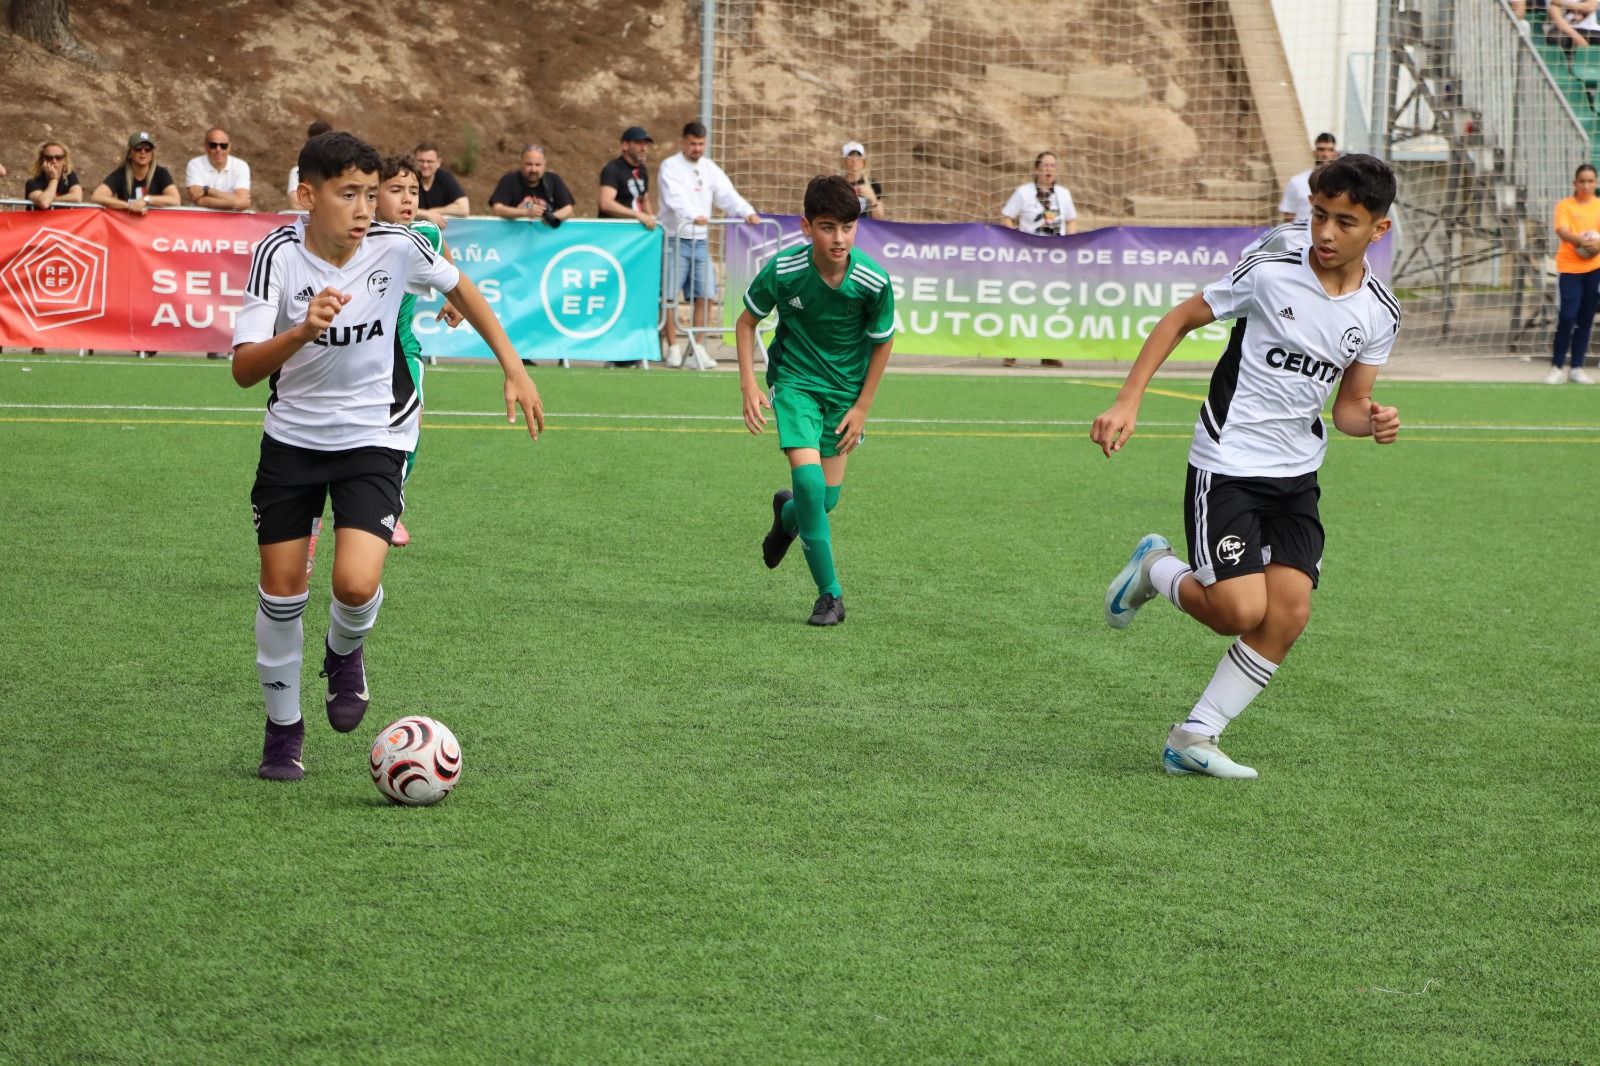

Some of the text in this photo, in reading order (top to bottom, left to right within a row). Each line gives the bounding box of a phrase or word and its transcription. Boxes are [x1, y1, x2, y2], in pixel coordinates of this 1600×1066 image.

[883, 242, 1229, 266] CAMPEONATO DE ESPAÑA
[890, 276, 1198, 307] SELECCIONE
[314, 319, 384, 347] EUTA
[894, 307, 1228, 341] UTONÓMICS
